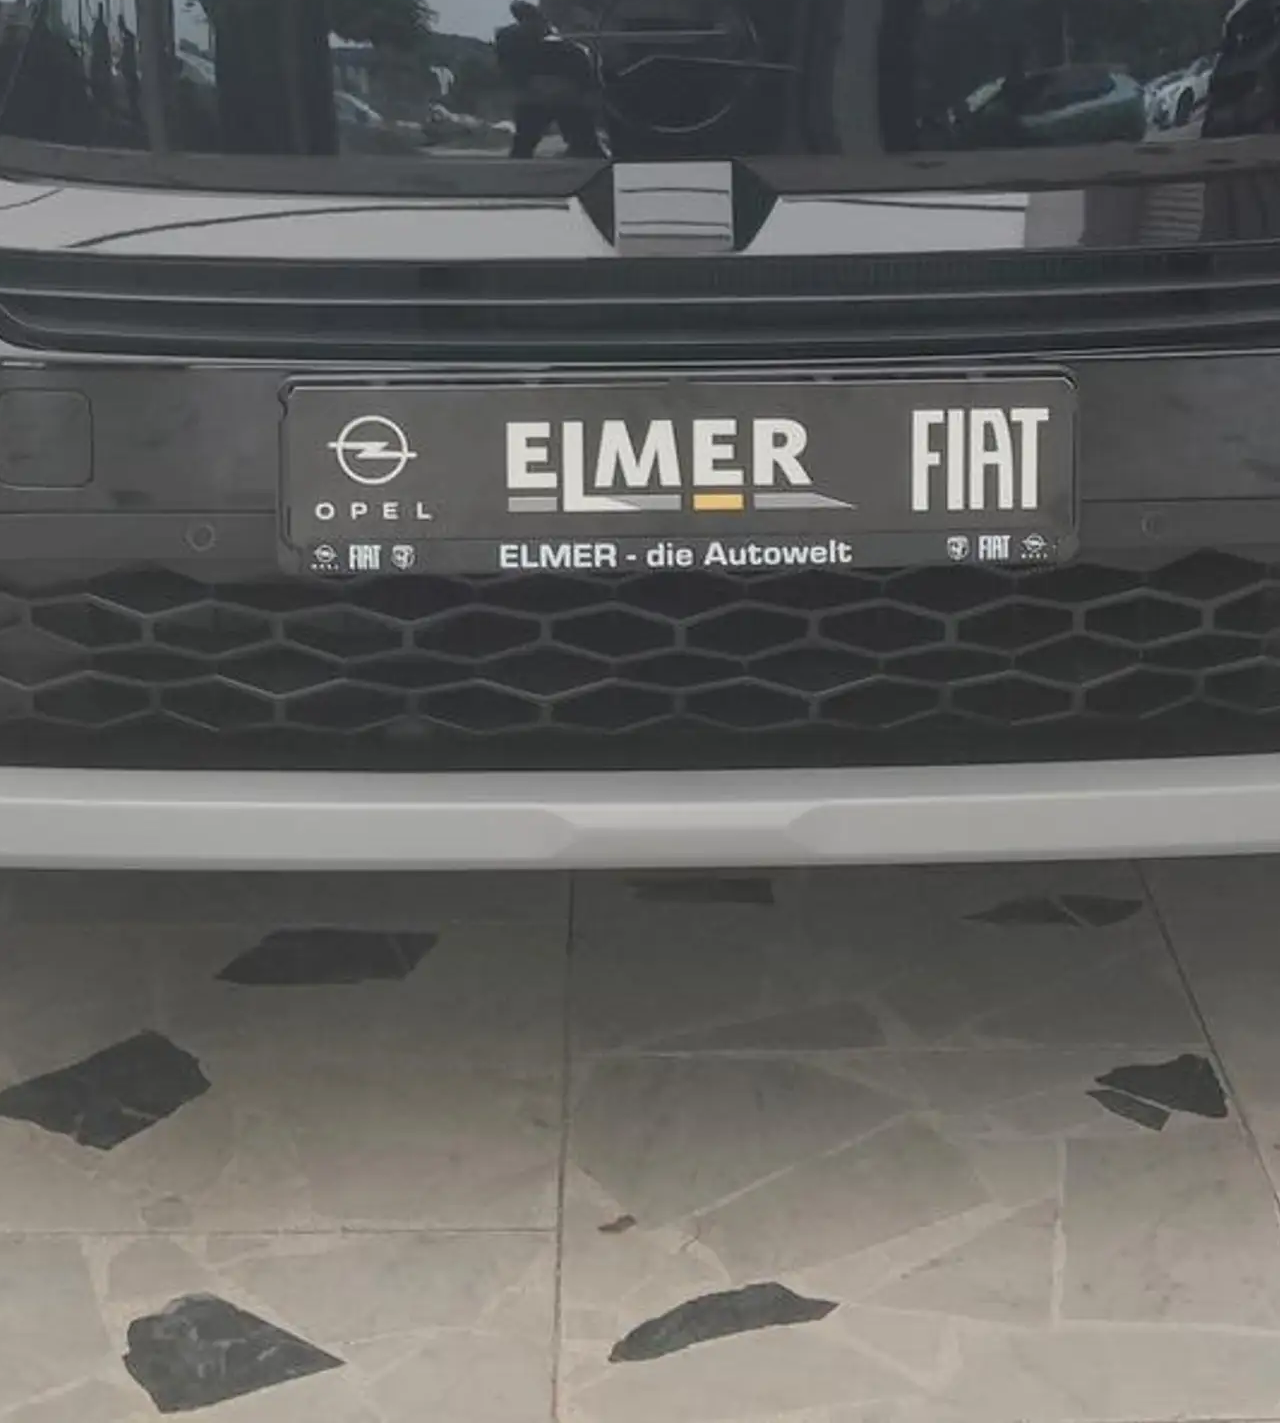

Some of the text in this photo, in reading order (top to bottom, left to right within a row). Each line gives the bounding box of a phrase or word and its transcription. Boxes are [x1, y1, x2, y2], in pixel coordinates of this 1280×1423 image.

[505, 419, 813, 513] ELMER
[912, 407, 1050, 511] FIAT
[314, 501, 432, 521] OPEL
[348, 543, 382, 571] FIAT
[499, 543, 617, 569] ELMER
[646, 542, 693, 567] die
[703, 539, 853, 567] Autowelt
[978, 534, 1012, 562] FIAT
